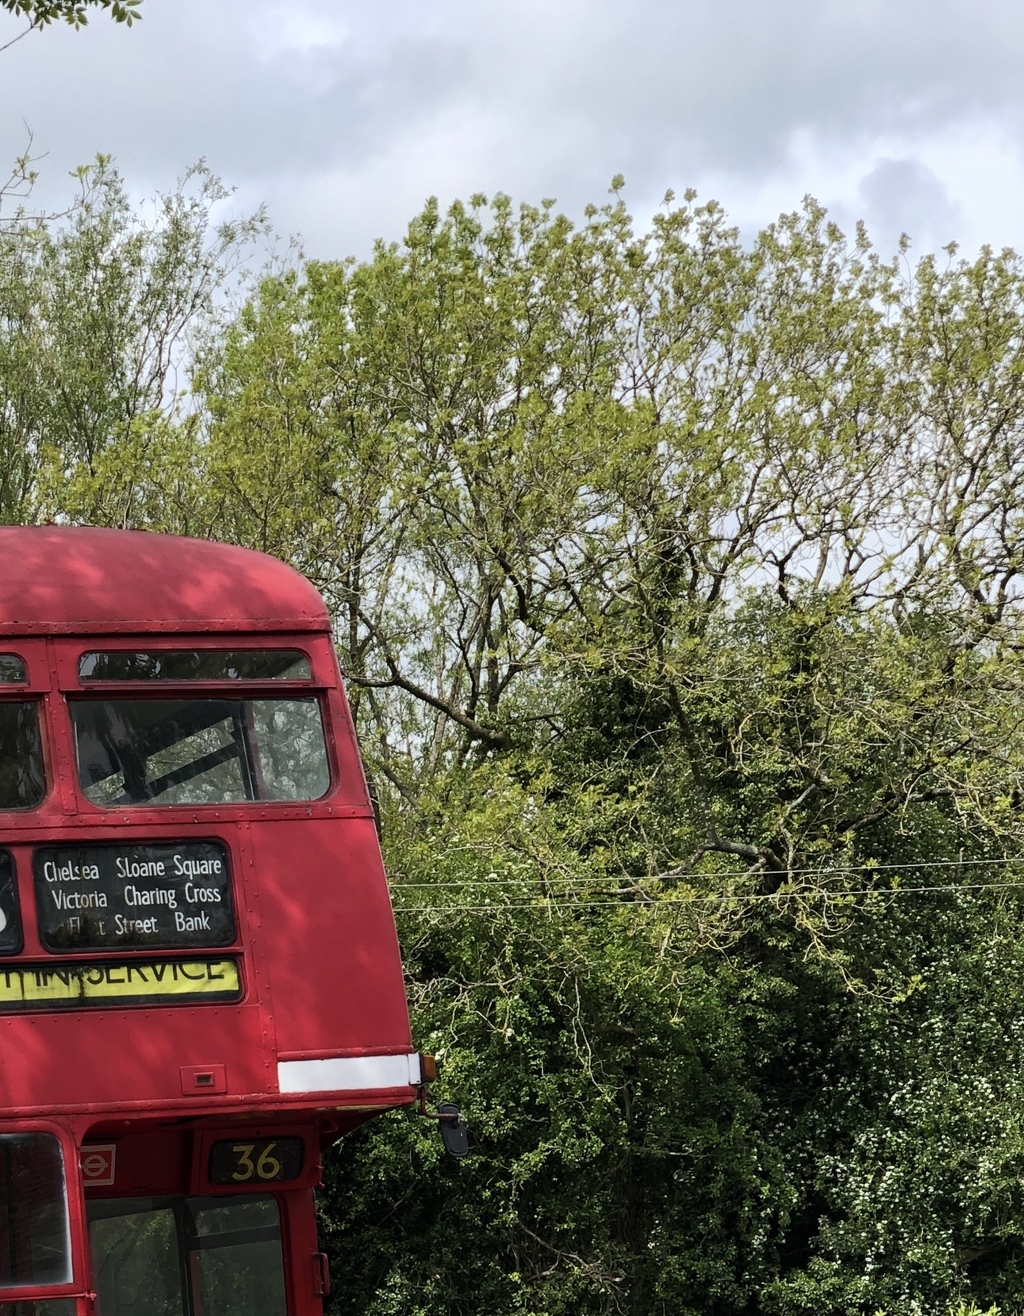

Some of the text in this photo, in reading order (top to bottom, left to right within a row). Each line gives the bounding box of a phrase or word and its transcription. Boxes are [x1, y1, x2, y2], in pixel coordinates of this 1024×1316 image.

[43, 854, 222, 882] Chelsea Sloane Square
[51, 882, 222, 910] Victoria Charing Cross
[68, 911, 212, 936] Flt Street Bank
[231, 1143, 281, 1181] 36
